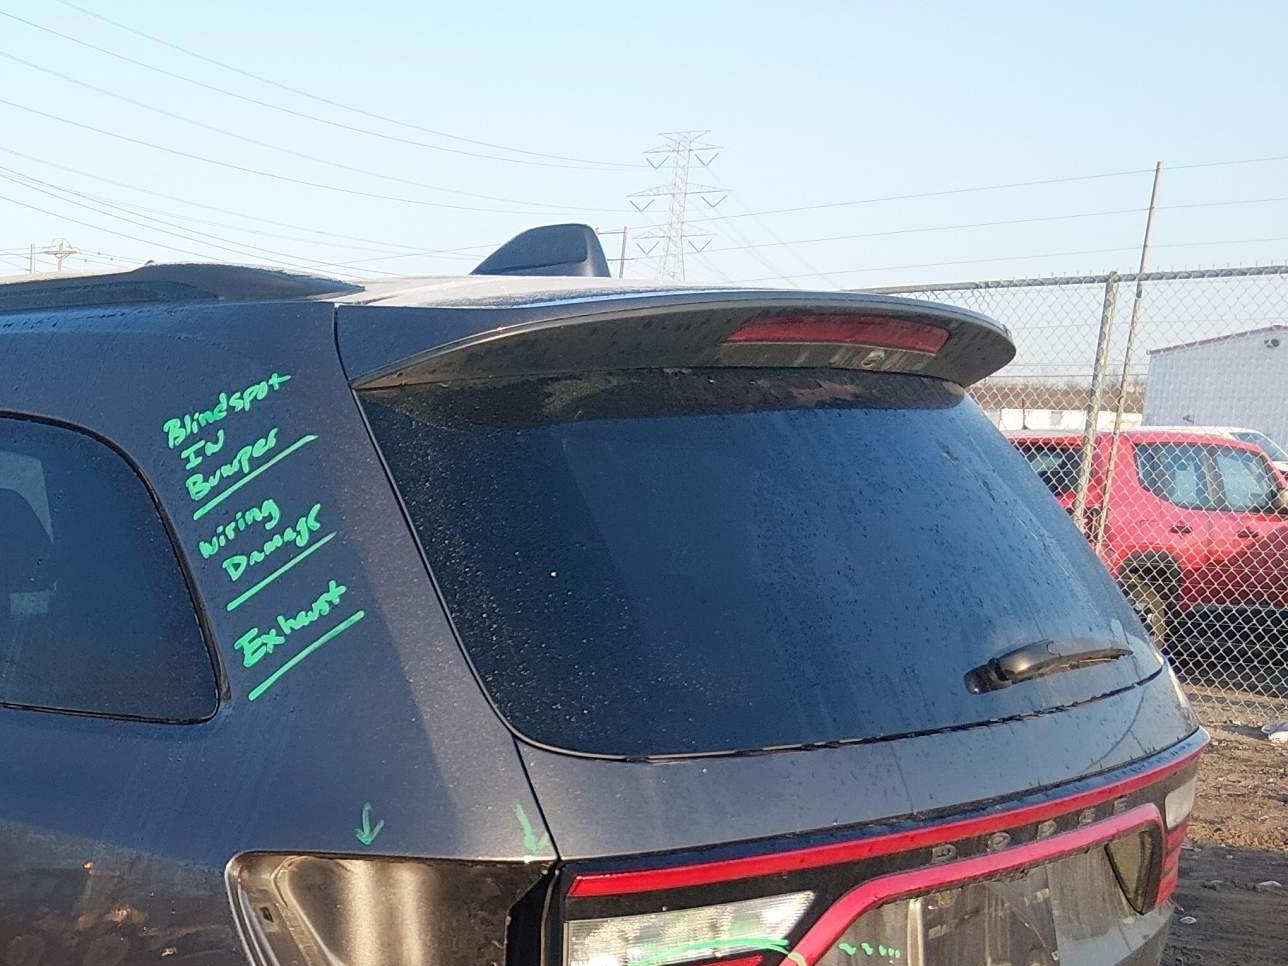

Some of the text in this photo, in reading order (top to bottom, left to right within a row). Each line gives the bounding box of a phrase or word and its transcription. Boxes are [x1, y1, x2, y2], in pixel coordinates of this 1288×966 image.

[163, 372, 291, 448] Blindspot
[185, 427, 278, 501] Bumper
[233, 580, 347, 668] Exhaust
